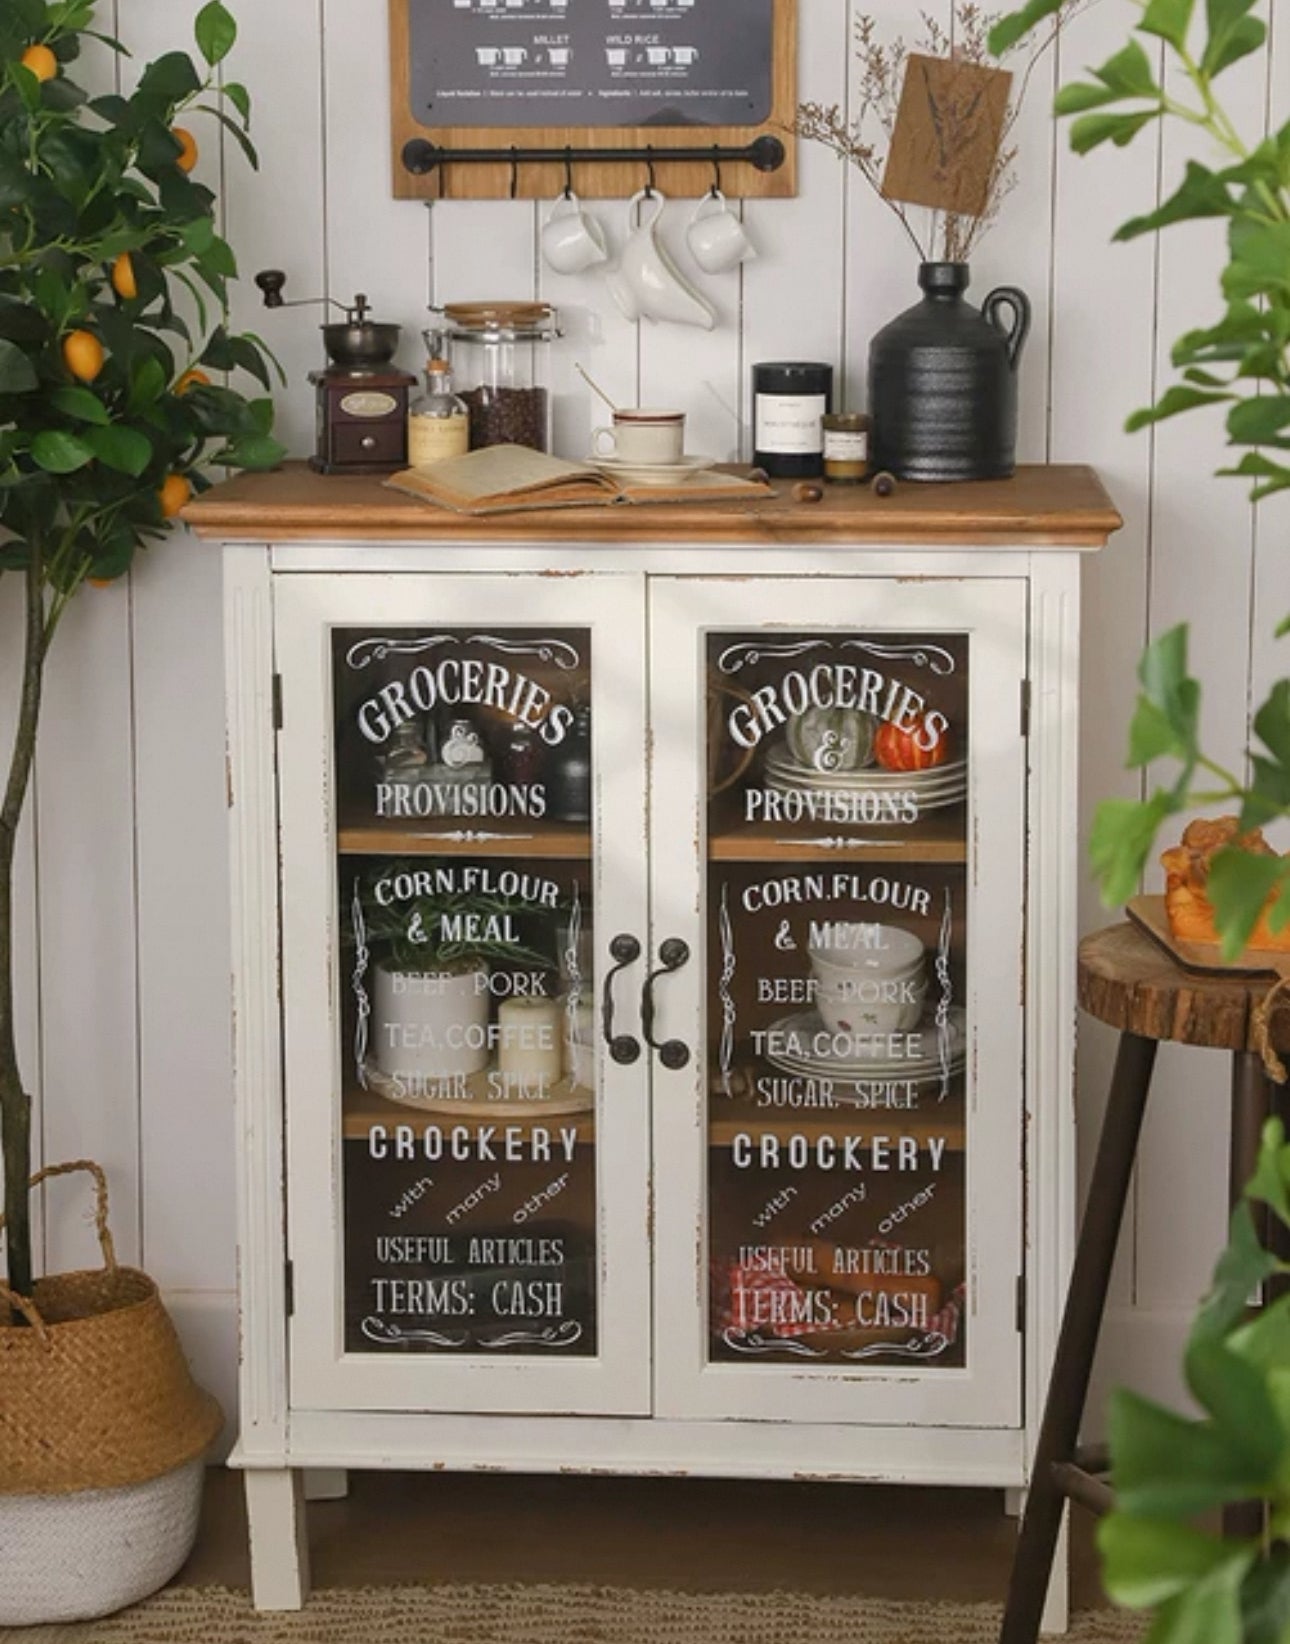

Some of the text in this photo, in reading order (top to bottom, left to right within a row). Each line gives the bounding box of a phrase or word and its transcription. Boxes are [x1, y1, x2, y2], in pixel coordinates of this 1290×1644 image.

[606, 35, 659, 44] WILD RICE
[358, 660, 574, 746] GROCERIES
[728, 664, 949, 751] GROCERIES
[813, 729, 850, 774] &
[375, 783, 546, 818] PROVISIONS
[745, 788, 919, 824] PROVISIONS
[407, 911, 520, 944] & MEAL
[774, 919, 889, 950] & MEAL
[474, 972, 548, 996] PORK
[839, 979, 917, 1004] PORK
[854, 1081, 919, 1110] SPICE
[368, 1124, 577, 1161] CROCKERY
[732, 1133, 945, 1171] CROCKERY
[388, 1172, 570, 1225] with many other
[752, 1182, 936, 1234] with many other
[376, 1236, 564, 1266] USEFUL ARTICLES
[738, 1246, 931, 1276] USEFUL ARTICLES
[370, 1279, 563, 1316] TERMS: CASH
[733, 1288, 929, 1328] TERMS: CASH
